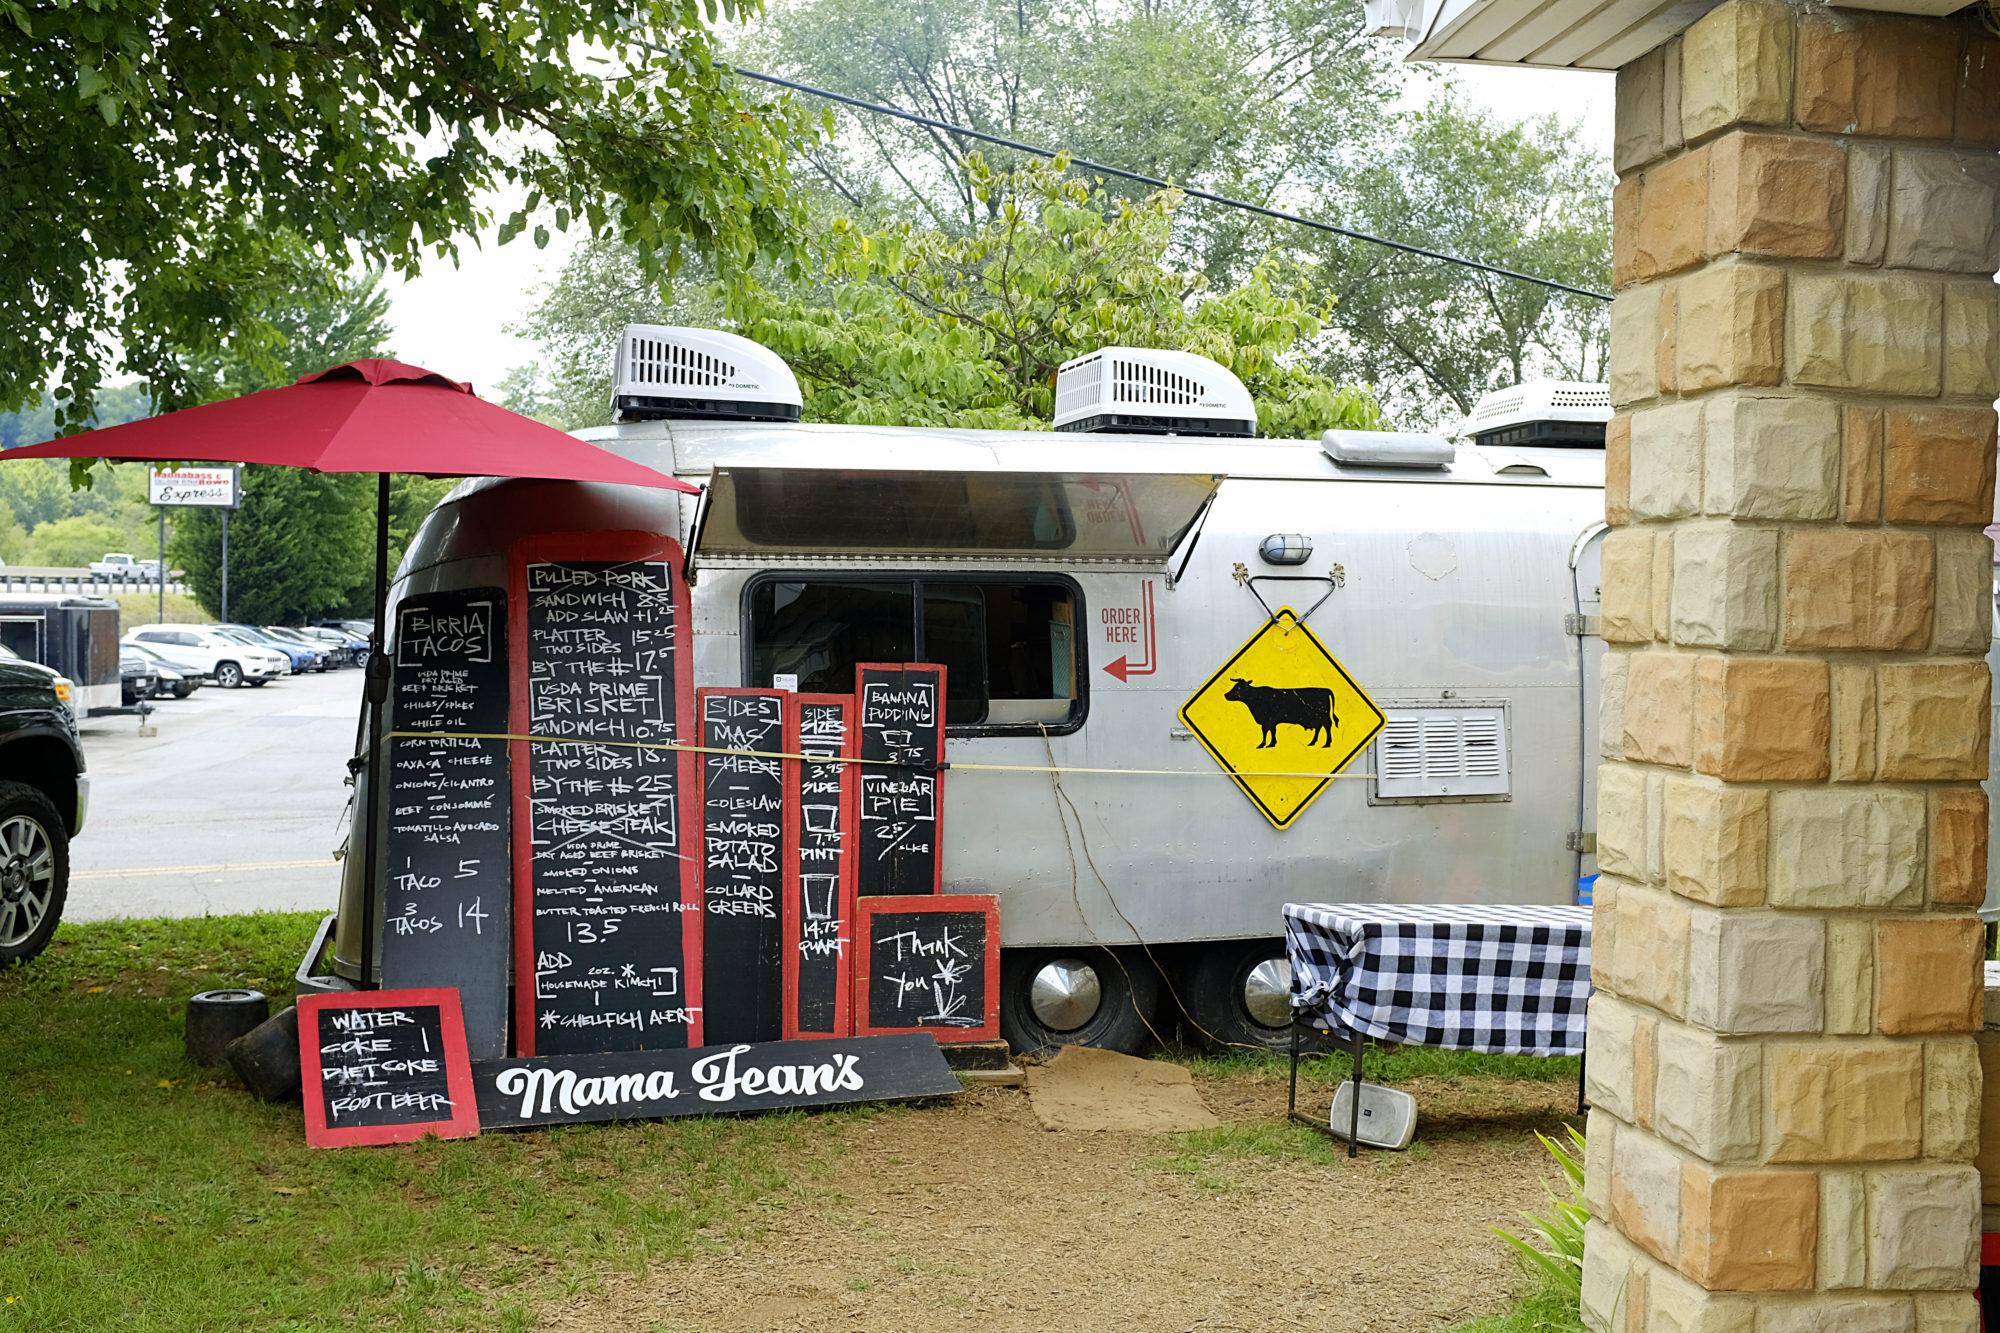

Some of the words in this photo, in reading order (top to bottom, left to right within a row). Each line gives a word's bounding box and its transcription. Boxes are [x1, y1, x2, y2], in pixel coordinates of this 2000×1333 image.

[159, 486, 223, 502] Express
[535, 568, 597, 586] PULLED
[602, 569, 659, 589] PORK
[535, 591, 626, 609] SANDWICH
[411, 612, 485, 637] BIRRIA
[546, 609, 579, 624] ADD
[581, 610, 628, 624] SLAW
[1101, 608, 1141, 624] ORDER
[532, 628, 612, 644] PLATTER
[1106, 627, 1137, 643] HERE
[403, 635, 482, 657] TACOS
[539, 645, 573, 655] TWO
[576, 643, 622, 654] SIDES
[532, 660, 562, 677] BY
[565, 660, 606, 677] THE
[606, 656, 633, 676] #
[539, 682, 582, 695] USDA
[589, 682, 649, 697] PRIME
[538, 696, 655, 716] BRISKET
[707, 698, 771, 717] SIDES
[872, 690, 929, 708] BANANA
[804, 707, 840, 719] SIDE
[868, 707, 931, 722] PUDDING
[411, 719, 444, 728] CHILE
[446, 717, 467, 726] OIL
[529, 718, 626, 738] SANDWICH
[800, 718, 847, 735] SIZES
[400, 738, 426, 748] CORN
[428, 738, 482, 749] TORTILLA
[531, 742, 620, 757] PLATTER
[397, 758, 442, 770] OAXACA
[448, 755, 493, 765] CHEESE
[539, 759, 581, 771] TWO
[586, 757, 633, 771] SIDES
[708, 756, 781, 776] CHEESE
[811, 763, 848, 779] 3.95
[532, 775, 566, 795] BY
[565, 778, 604, 796] THE
[606, 776, 634, 796] #
[636, 774, 672, 792] 25
[802, 781, 843, 795] SIDE
[866, 780, 932, 796] VINEGAR
[535, 804, 594, 816] SMOKED
[595, 801, 667, 817] BRISKET
[706, 794, 782, 812] COLESLAW
[869, 796, 919, 815] PIE
[393, 823, 452, 834] TOMATILLO
[453, 822, 500, 832] AVOCADO
[537, 817, 672, 836] CHEESESTEAK
[705, 820, 780, 838] SMOKED
[424, 833, 461, 844] SALSA
[705, 836, 776, 857] POTATO
[560, 850, 586, 859] AGED
[590, 850, 618, 858] BEEF
[621, 849, 667, 859] BRISKET
[708, 852, 778, 873] SALAD
[798, 848, 844, 861] PINT
[454, 859, 481, 878] 5
[542, 867, 587, 877] SMOKED
[592, 865, 639, 876] ONIONS
[394, 873, 441, 891] TACO
[536, 886, 587, 896] MELTED
[594, 883, 658, 895] AMERICAN
[705, 883, 774, 900] COLLARD
[405, 902, 418, 915] 3
[458, 896, 489, 935] 14
[536, 907, 582, 917] BUTTER
[582, 906, 627, 916] TOASTED
[630, 902, 669, 913] FRENCH
[672, 901, 700, 912] ROLL
[708, 899, 776, 918] GREENS
[387, 916, 443, 936] TACOS
[803, 920, 845, 939] 14.75
[799, 937, 851, 960] QUART
[877, 926, 968, 962] Thank
[537, 951, 572, 970] ADD
[541, 979, 608, 991] HOUSEMADE
[615, 977, 662, 990] KIMCHI
[883, 971, 929, 1008] You
[332, 1009, 415, 1030] WATER
[650, 1007, 703, 1026] ALERT
[320, 1037, 392, 1055] COKE
[321, 1063, 380, 1080] DIET
[381, 1059, 439, 1076] COKE
[496, 1067, 680, 1119] Mama
[691, 1044, 864, 1101] Jean's
[331, 1092, 392, 1118] ROOT
[391, 1092, 456, 1111] BEER
